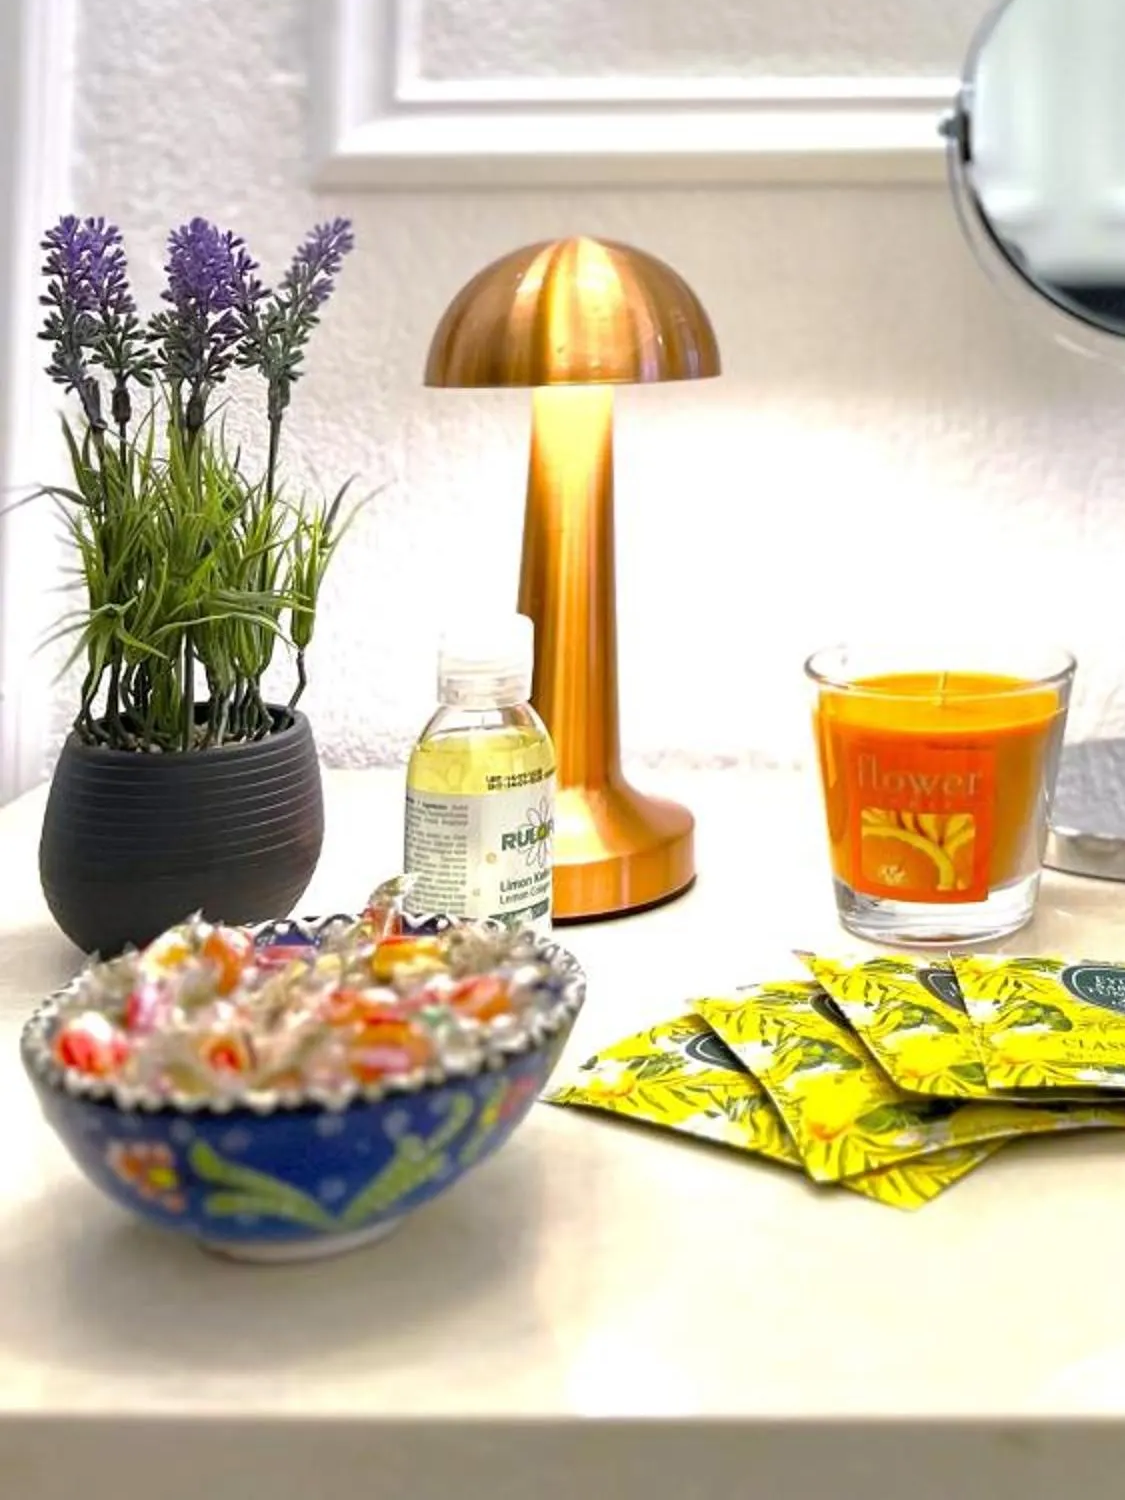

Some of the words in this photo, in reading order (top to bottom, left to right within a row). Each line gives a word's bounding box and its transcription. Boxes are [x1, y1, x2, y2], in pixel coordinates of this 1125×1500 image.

[857, 754, 982, 795] flower
[500, 874, 533, 892] Limon
[500, 891, 529, 905] Lemon
